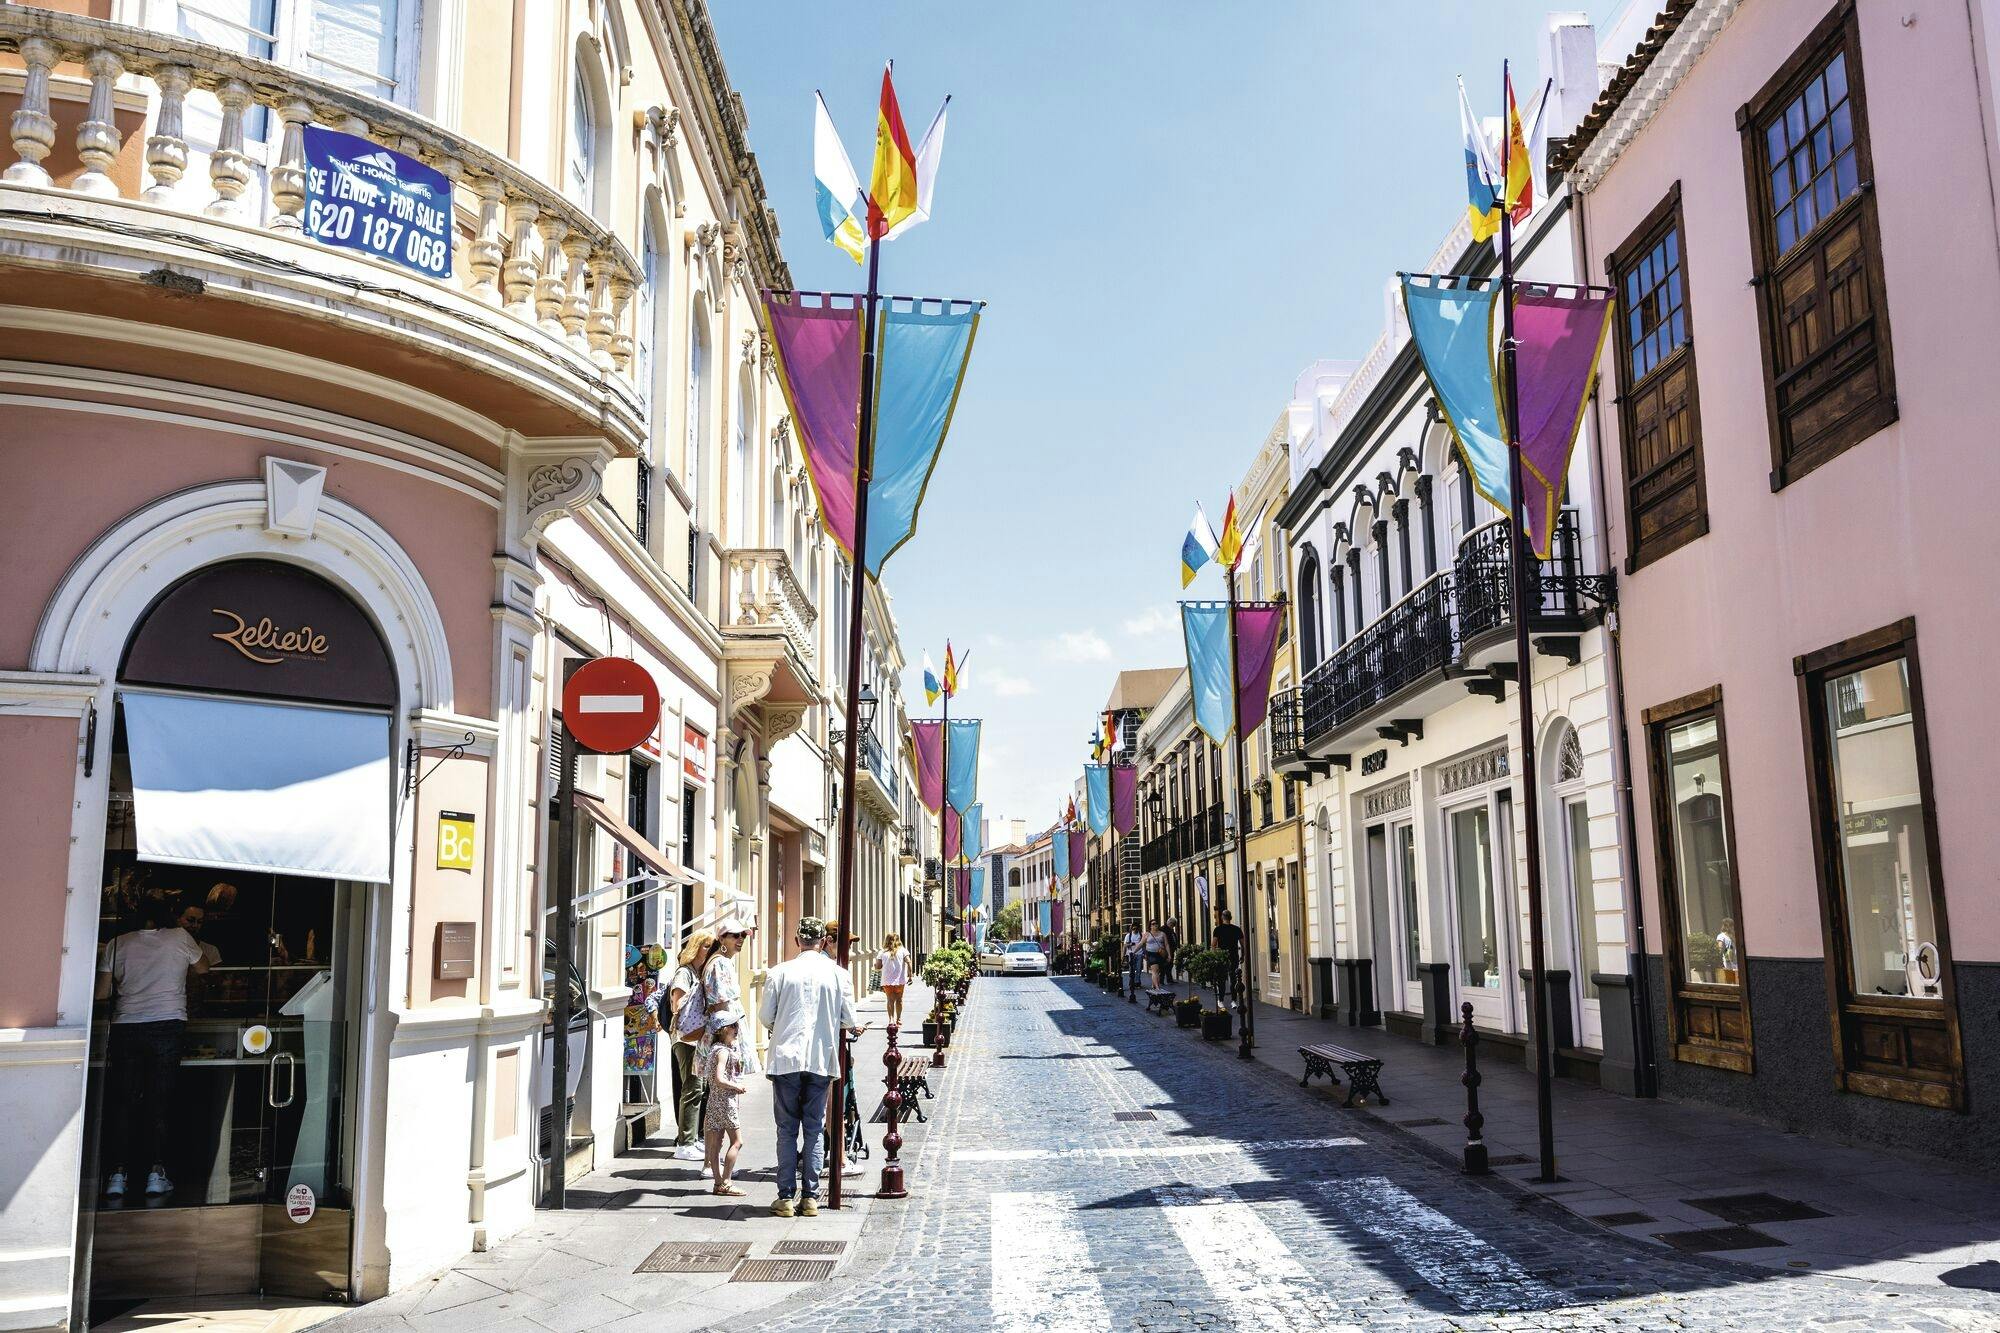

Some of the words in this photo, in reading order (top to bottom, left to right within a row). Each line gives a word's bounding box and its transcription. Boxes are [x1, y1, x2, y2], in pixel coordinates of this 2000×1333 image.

[308, 166, 328, 195] SE
[331, 171, 378, 208] VENDE
[388, 191, 415, 222] FOR
[415, 202, 446, 236] SALE
[363, 165, 398, 186] HOMES
[309, 199, 355, 240] 620
[362, 213, 404, 255] 187
[406, 229, 447, 272] 068
[212, 609, 329, 664] Relieve
[441, 824, 472, 862] Bc
